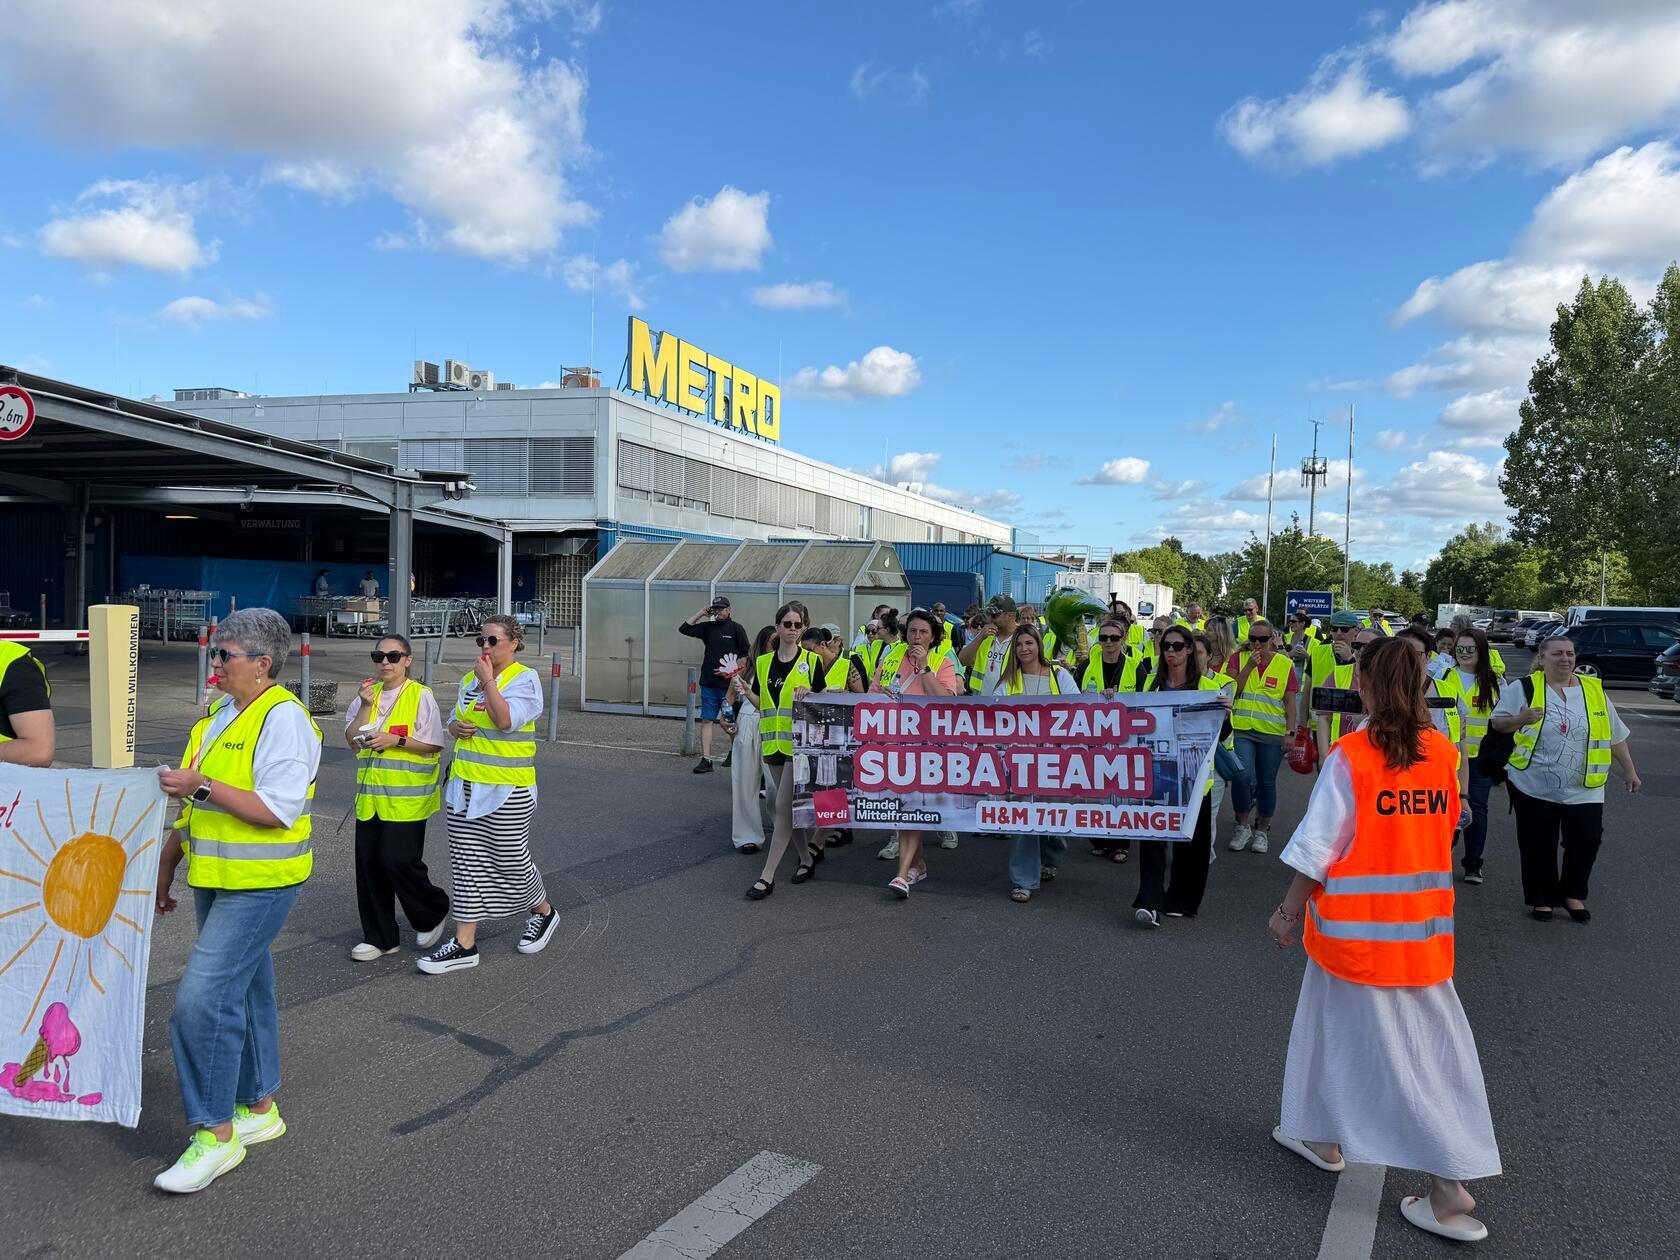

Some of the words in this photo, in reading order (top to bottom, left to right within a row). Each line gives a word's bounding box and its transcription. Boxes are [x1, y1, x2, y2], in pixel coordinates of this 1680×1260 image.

[627, 315, 780, 441] METRO
[241, 519, 301, 529] VERWALTUNG
[127, 613, 139, 694] WILLKOMMEN
[126, 698, 136, 753] HERZLICH
[859, 708, 921, 736] MIR
[931, 709, 1041, 738] HALDN
[1050, 709, 1121, 737] ZAM
[859, 750, 1001, 787] SUBBA
[1011, 753, 1146, 791] TEAM!
[856, 799, 899, 810] Handel
[856, 810, 940, 822] Mittelfranken
[1376, 789, 1449, 816] CREW
[981, 806, 1029, 826] H&M
[1036, 808, 1068, 826] 717
[1075, 810, 1187, 832] ERLANGE
